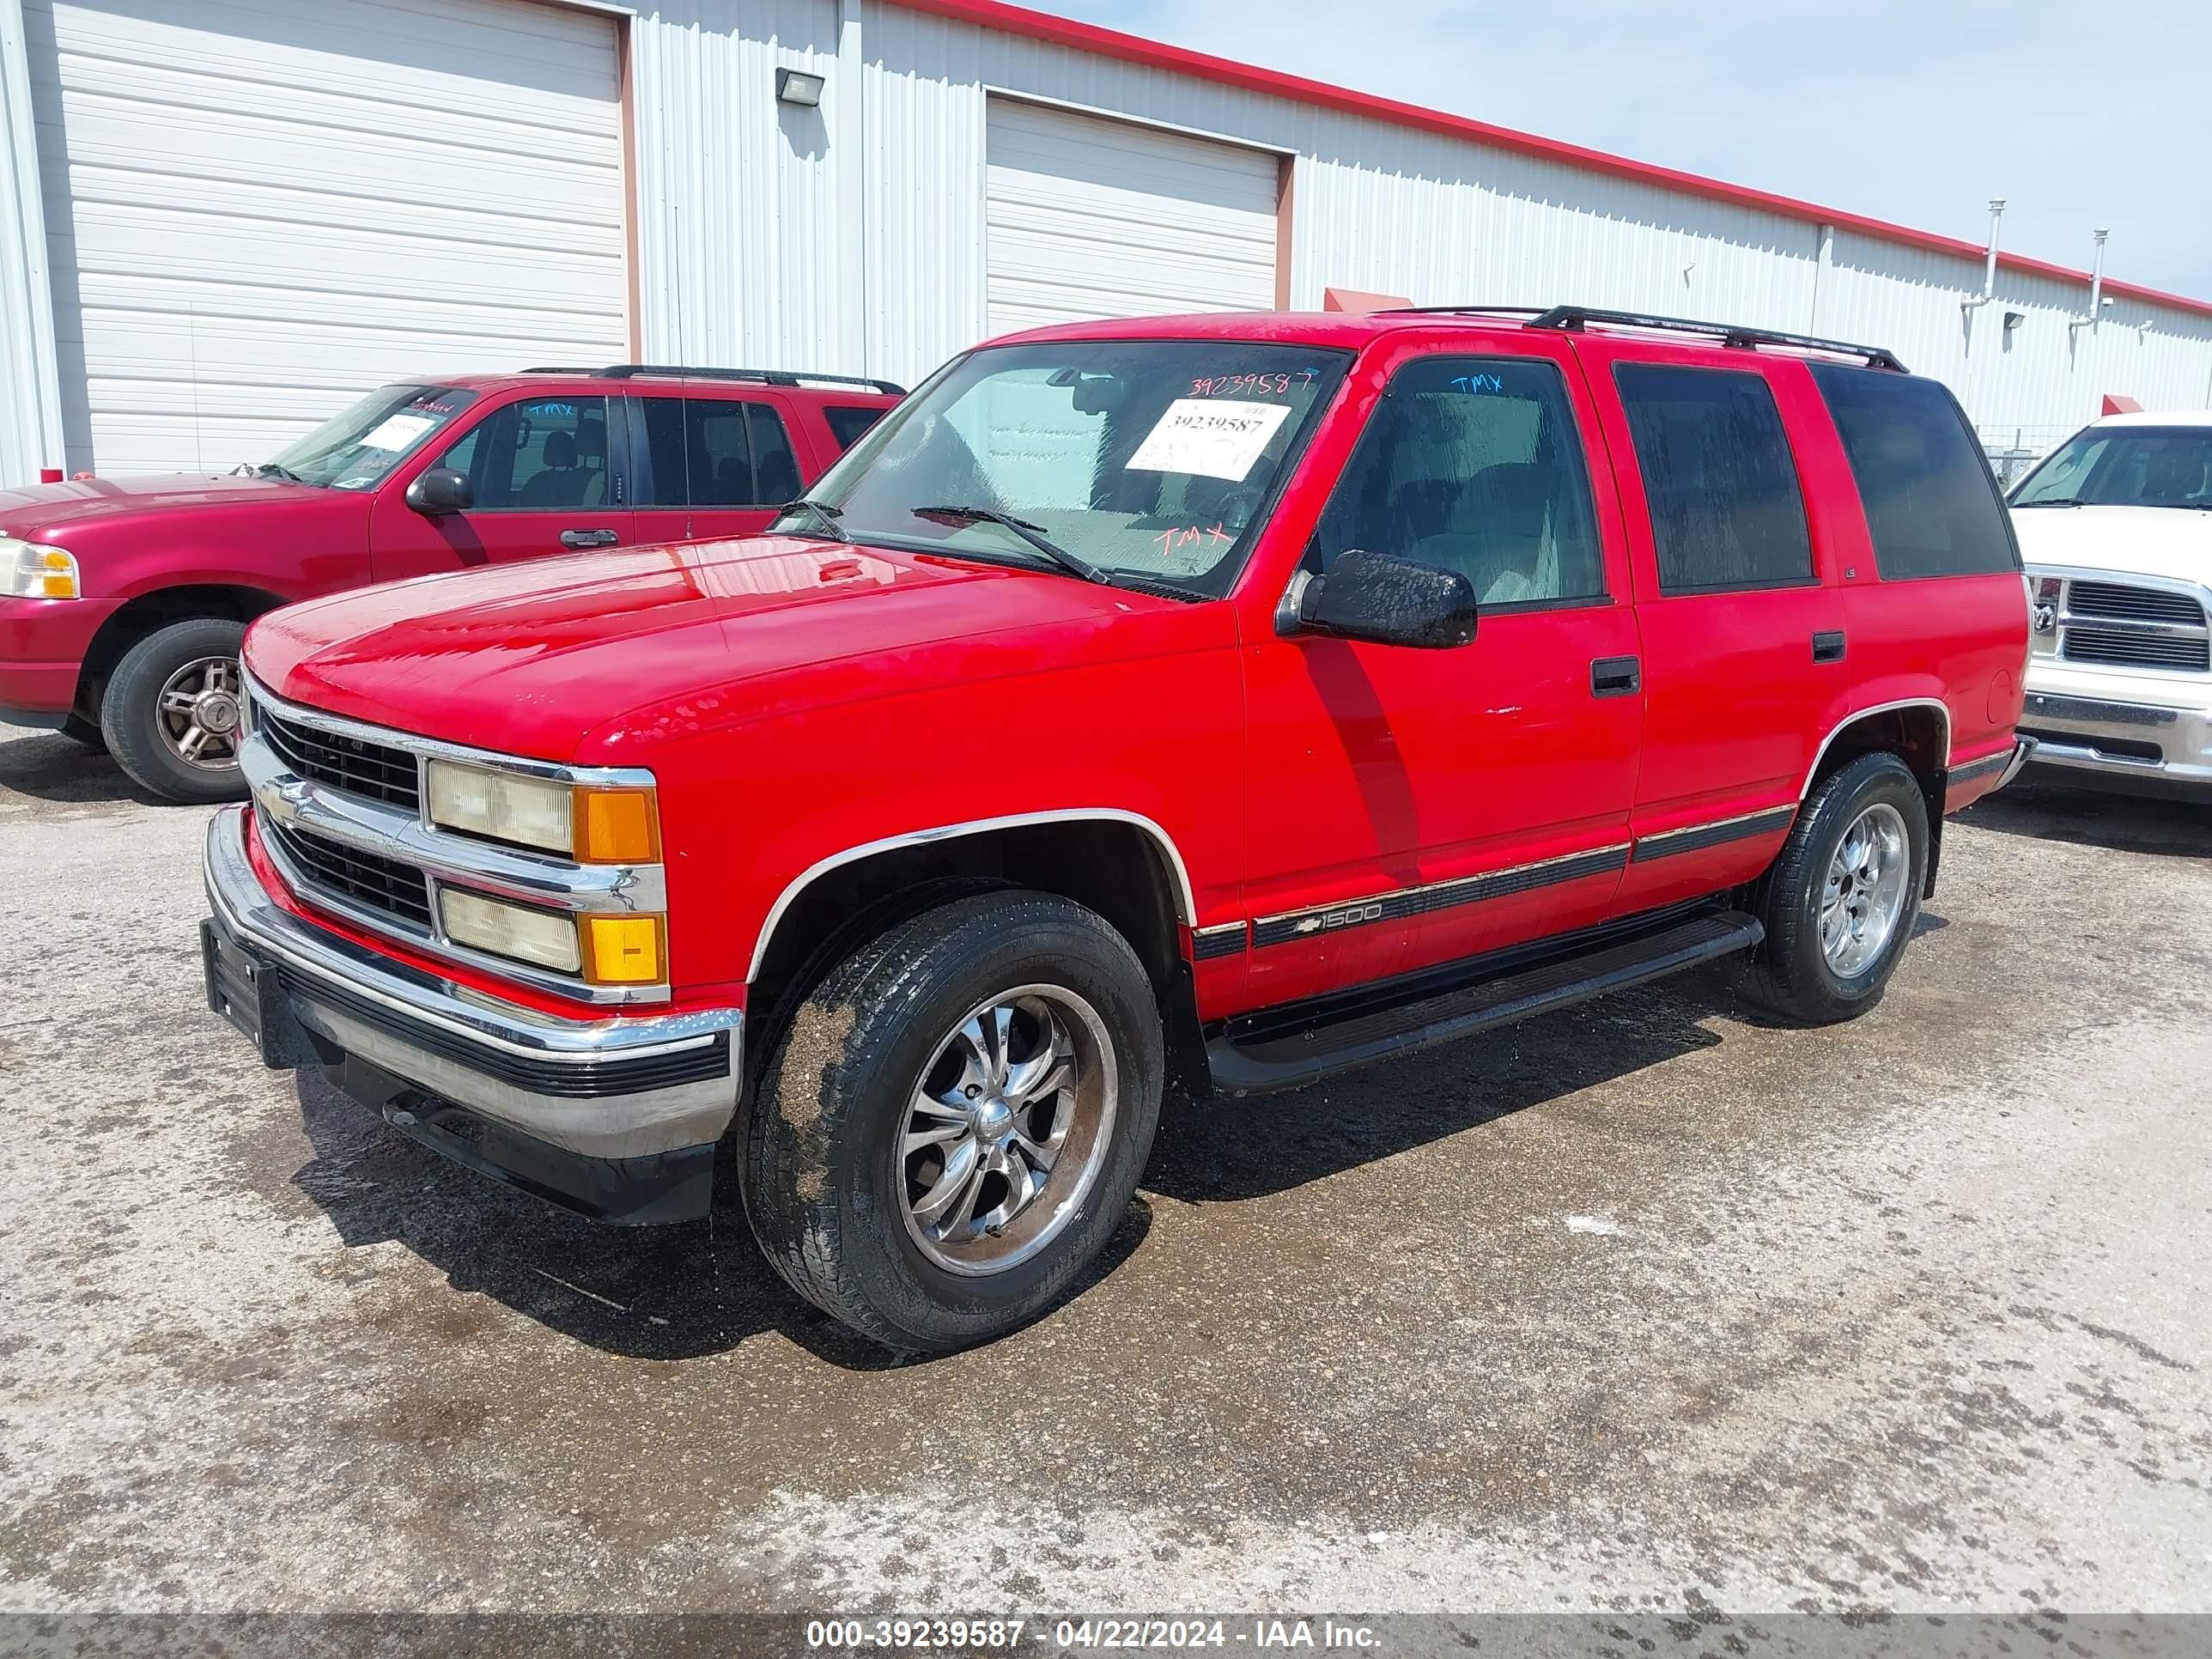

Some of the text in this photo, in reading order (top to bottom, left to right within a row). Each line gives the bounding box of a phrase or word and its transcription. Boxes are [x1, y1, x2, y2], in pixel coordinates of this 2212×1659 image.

[1186, 372, 1312, 398] 39239587
[1449, 374, 1503, 394] TMX
[528, 404, 573, 417] TMX
[1167, 415, 1264, 434] 39239587
[1152, 520, 1234, 556] TMX
[1322, 903, 1382, 929] 1500
